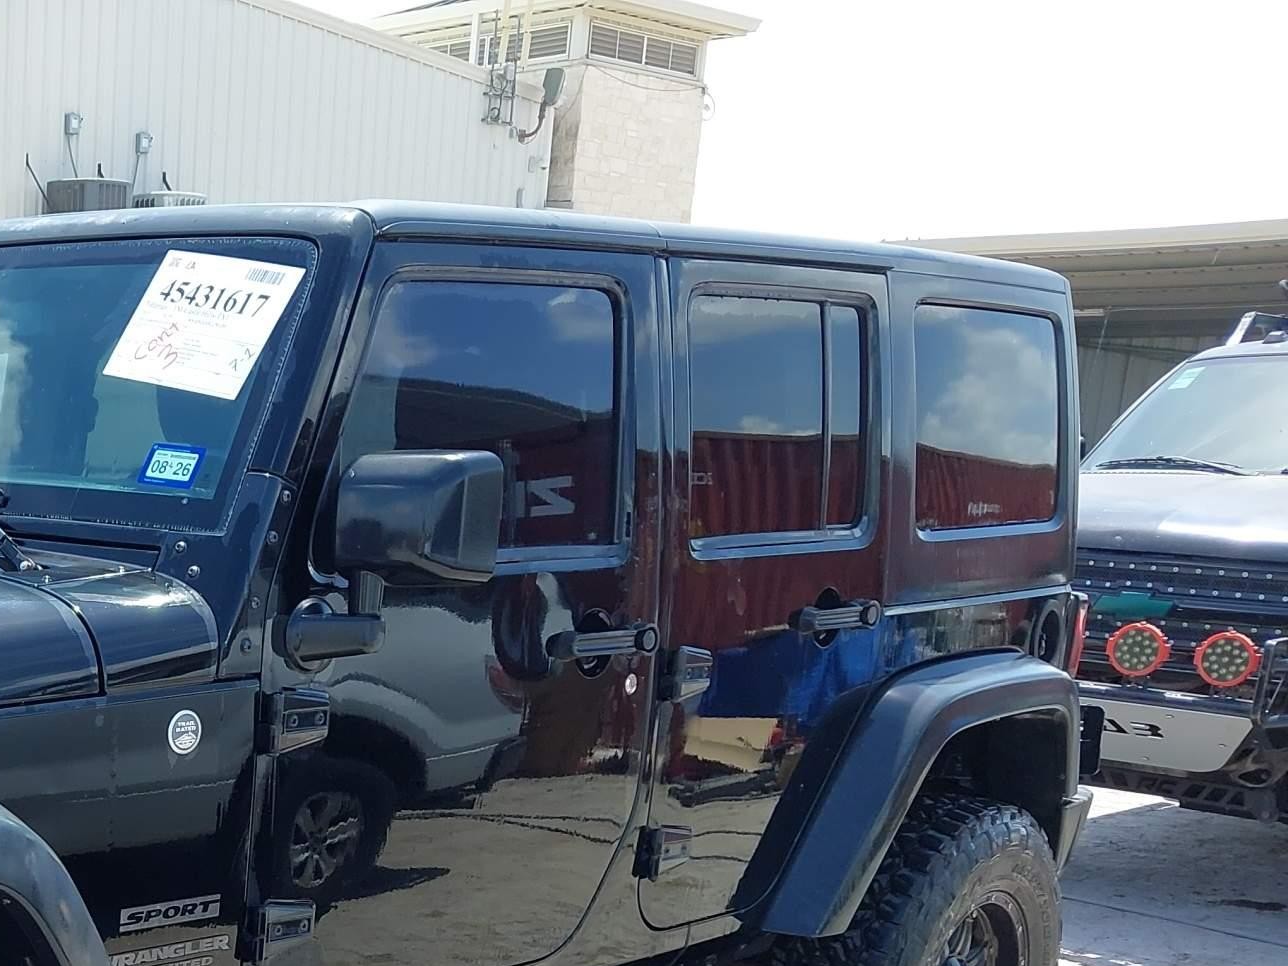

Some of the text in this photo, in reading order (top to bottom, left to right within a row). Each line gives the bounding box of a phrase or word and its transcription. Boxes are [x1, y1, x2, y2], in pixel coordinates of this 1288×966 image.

[159, 279, 272, 318] 45431617
[151, 459, 192, 477] 08 26
[122, 899, 220, 926] SPORT
